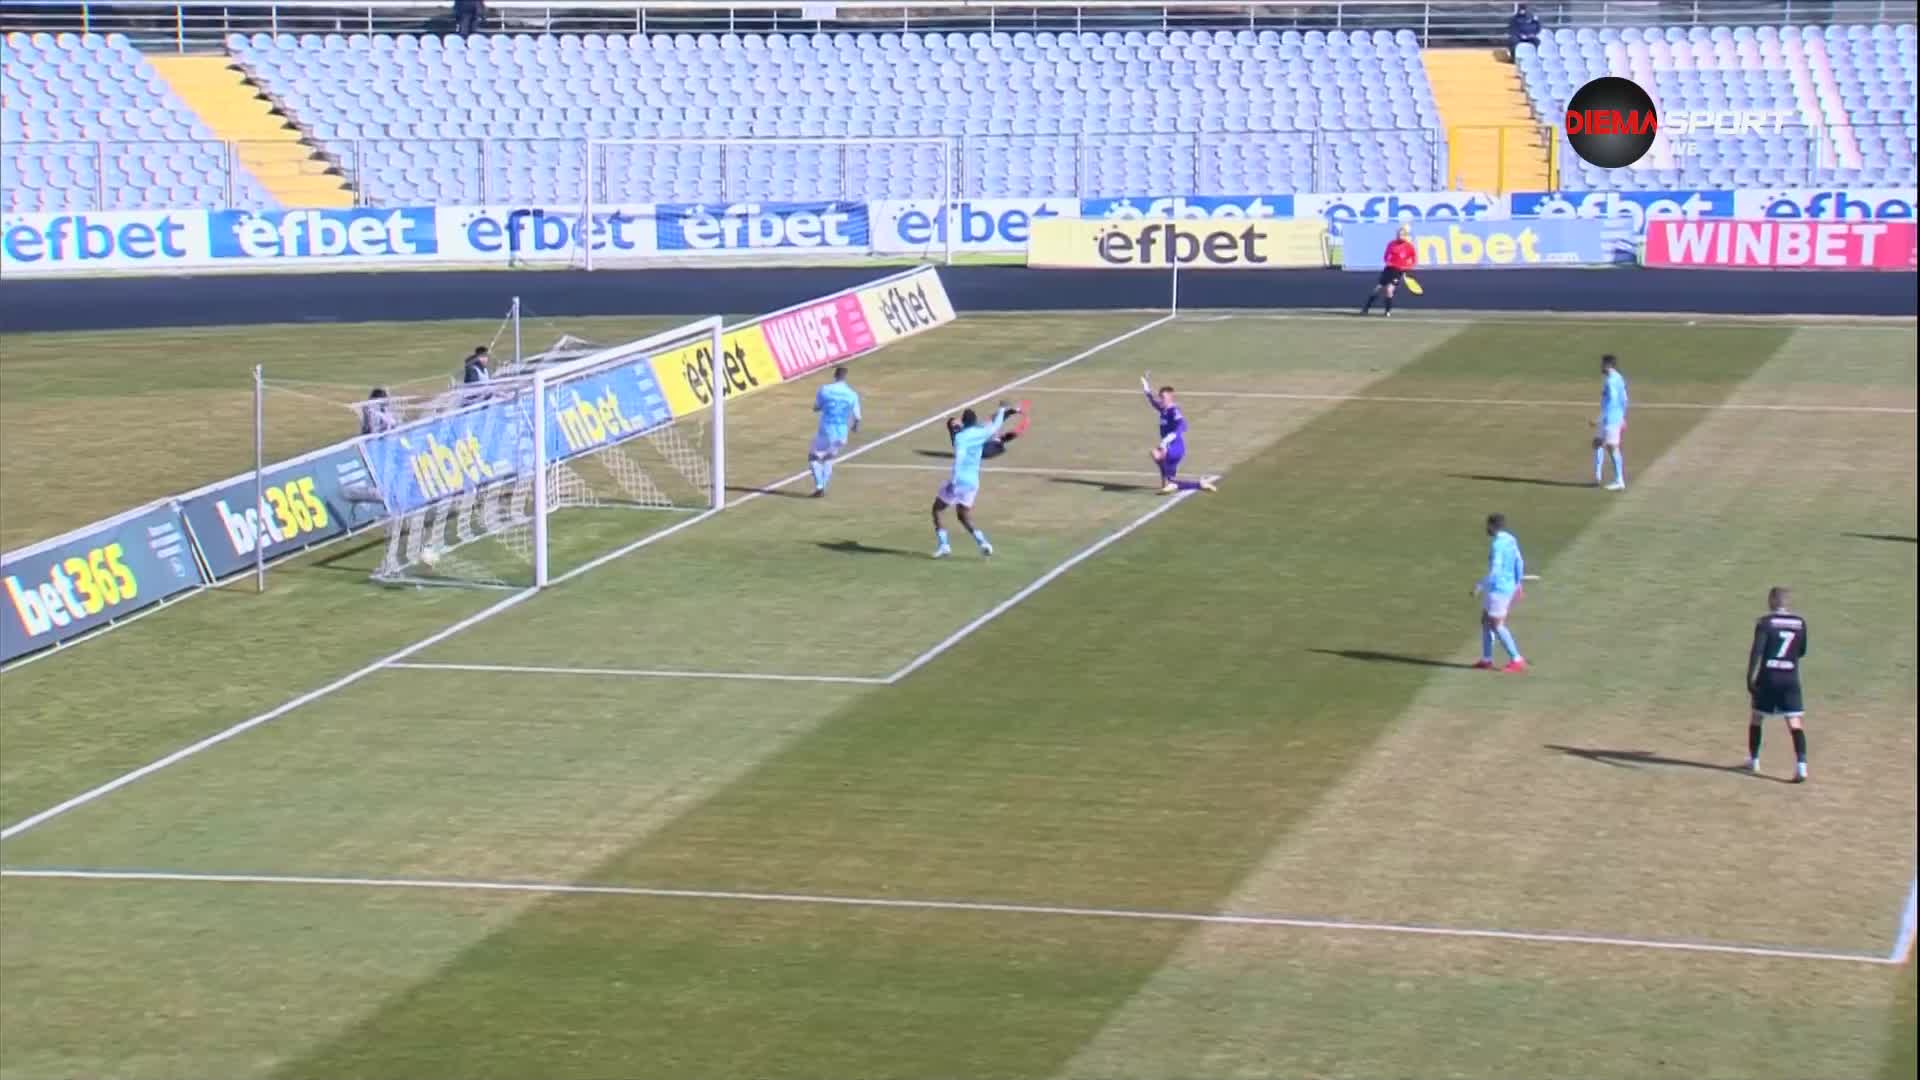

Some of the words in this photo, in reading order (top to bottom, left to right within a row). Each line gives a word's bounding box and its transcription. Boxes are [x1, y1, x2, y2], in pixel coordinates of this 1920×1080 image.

[680, 203, 849, 249] efbet
[1761, 191, 1917, 218] efbe
[1, 215, 187, 262] efbet
[233, 209, 416, 256] efbet
[462, 208, 635, 252] efbet
[1093, 223, 1268, 264] efbet
[1416, 224, 1541, 265] nbet
[1665, 222, 1888, 266] WINBET
[879, 281, 937, 335] efbet
[764, 301, 849, 374] WINBET
[548, 383, 634, 452] inbet
[400, 424, 494, 500] inbet
[216, 476, 329, 556] bet365
[5, 542, 138, 637] bet365
[1776, 631, 1796, 658] 7
